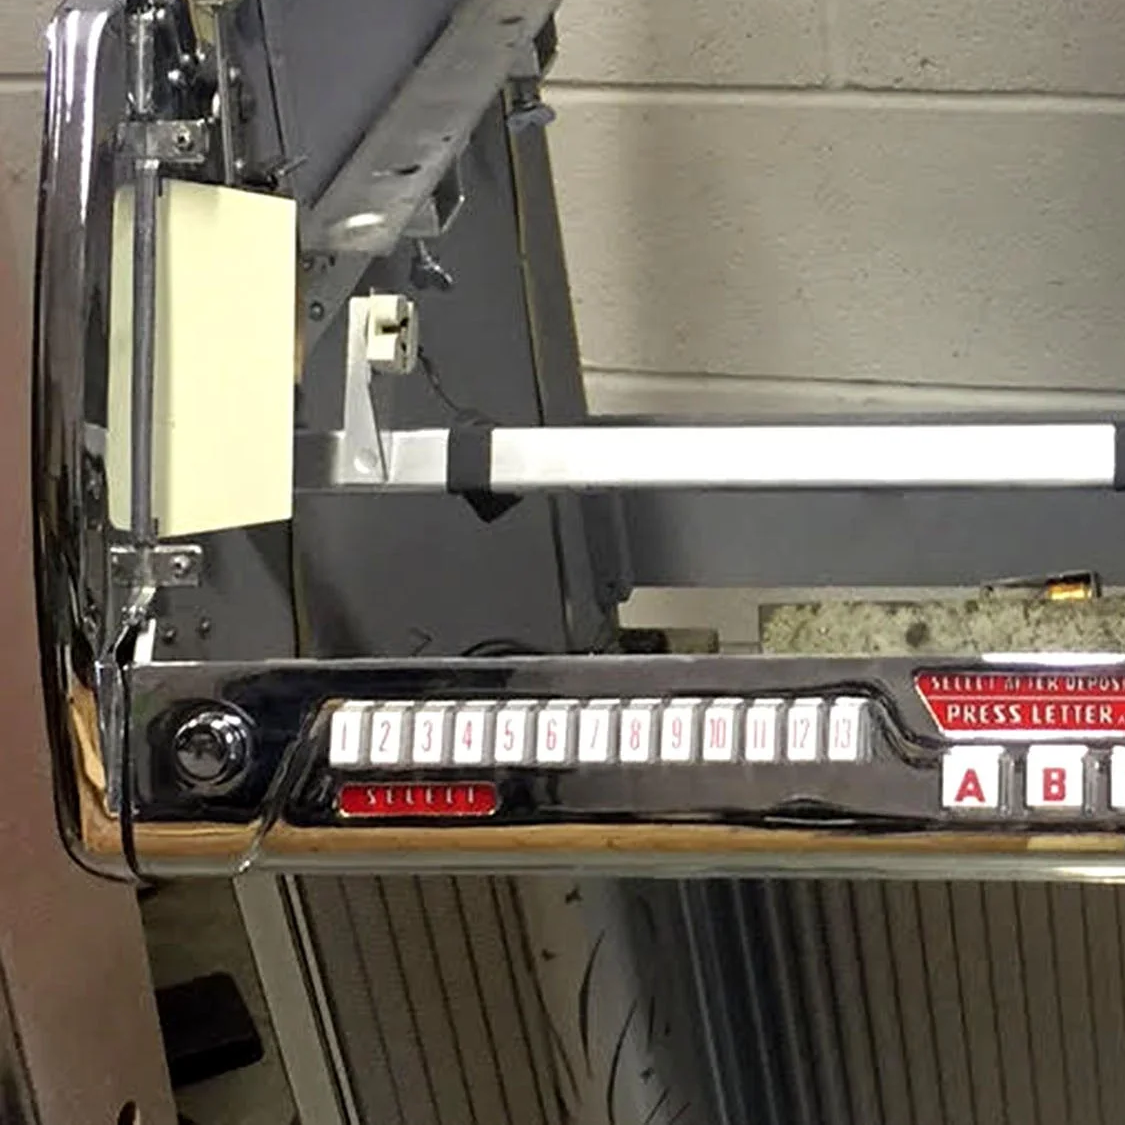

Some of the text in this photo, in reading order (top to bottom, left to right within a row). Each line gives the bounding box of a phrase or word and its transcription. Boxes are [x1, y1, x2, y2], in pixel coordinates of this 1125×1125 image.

[930, 675, 996, 691] SELECT
[1004, 675, 1059, 691] AFTER
[946, 703, 1022, 724] PRESS
[1031, 703, 1113, 724] LETTER
[378, 719, 392, 753] 2
[420, 719, 433, 752] 3
[462, 720, 473, 750] 4
[503, 718, 516, 752] 5
[545, 718, 558, 751] 6
[589, 717, 600, 750] 7
[629, 717, 642, 751] 8
[671, 717, 682, 750] 9
[708, 717, 727, 749] 10
[752, 718, 767, 750] 11
[791, 717, 810, 749] 12
[833, 717, 852, 749] 13
[954, 768, 986, 803] A
[1042, 767, 1068, 803] B
[366, 787, 475, 805] SELECT
